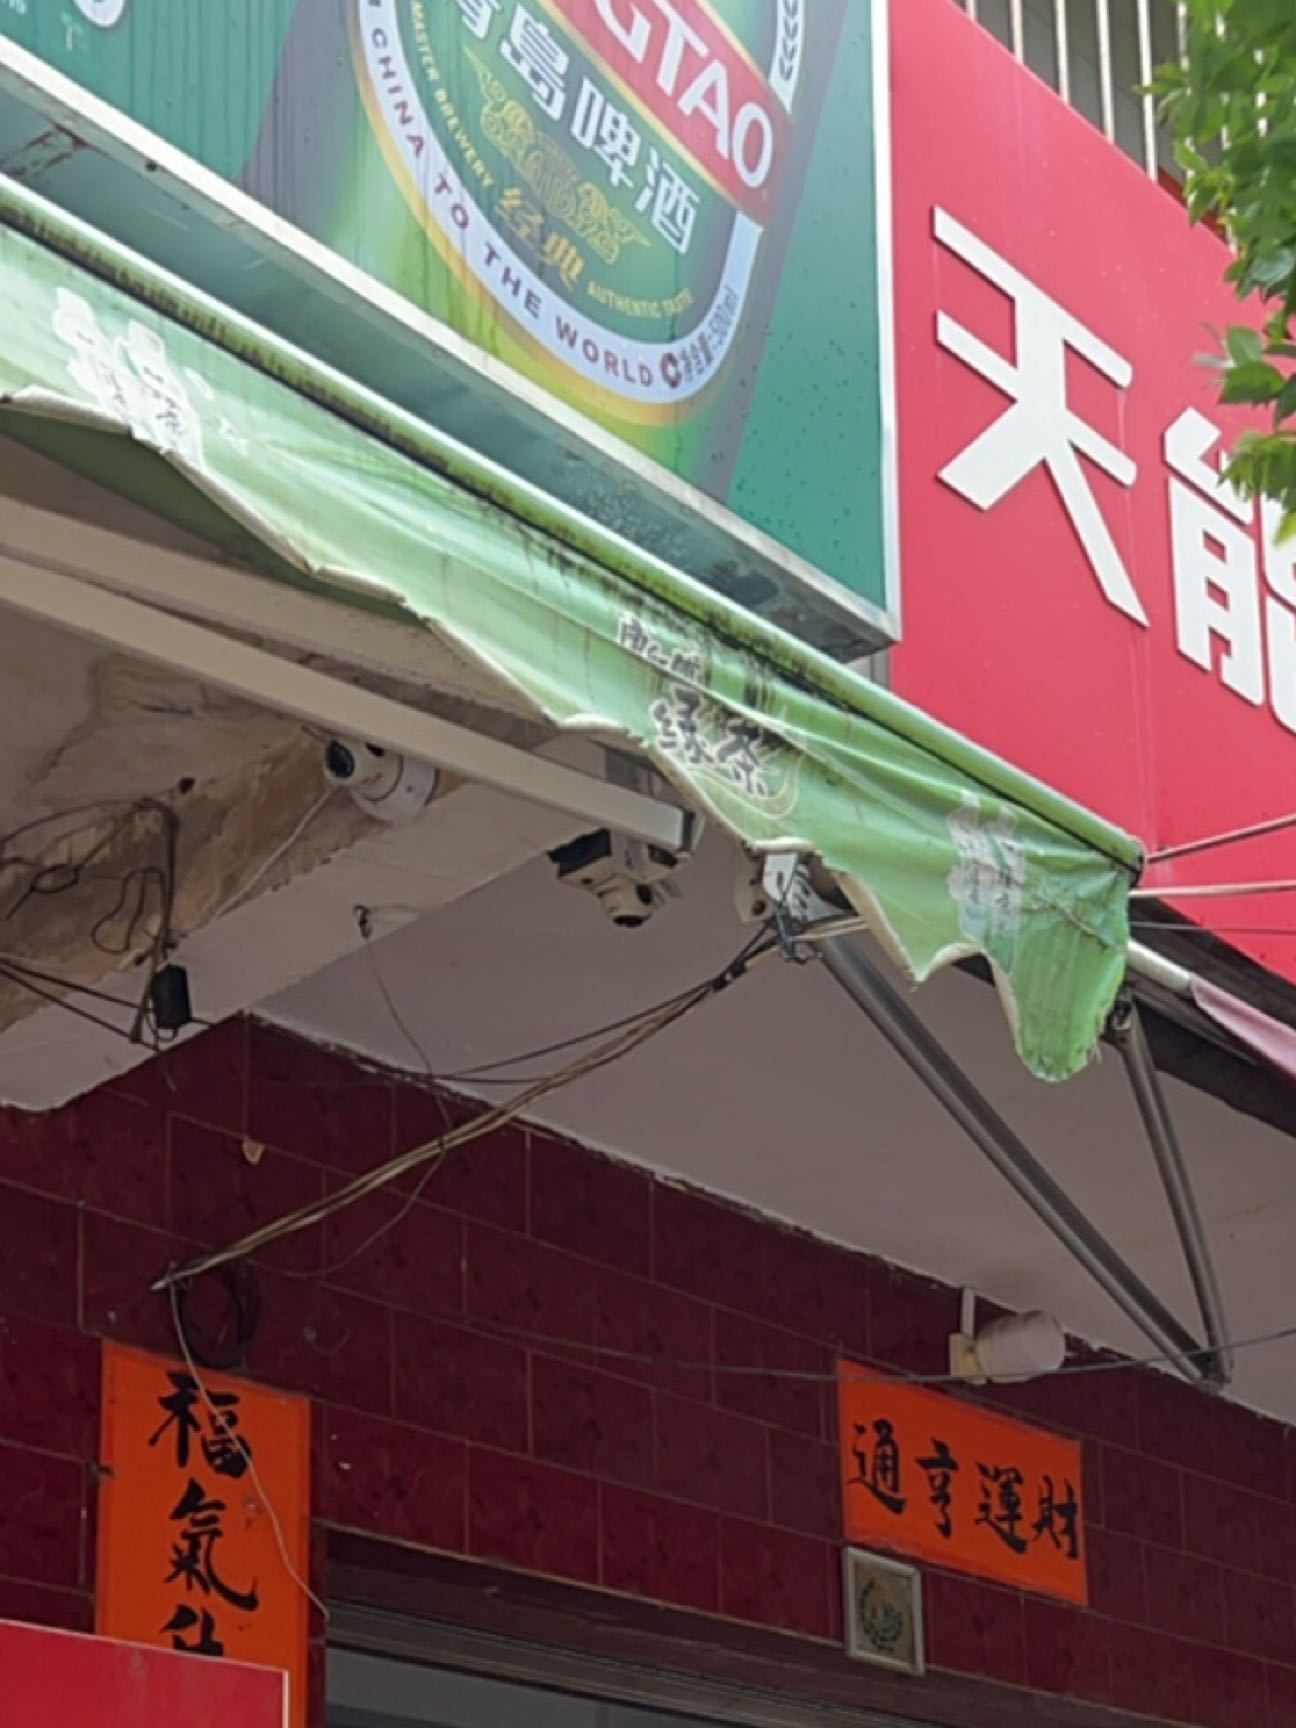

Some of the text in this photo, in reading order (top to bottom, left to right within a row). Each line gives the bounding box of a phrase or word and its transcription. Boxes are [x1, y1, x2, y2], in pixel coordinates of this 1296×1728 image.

[371, 28, 654, 387] CHINA TO THE WORLD
[434, 88, 494, 187] BREWERY
